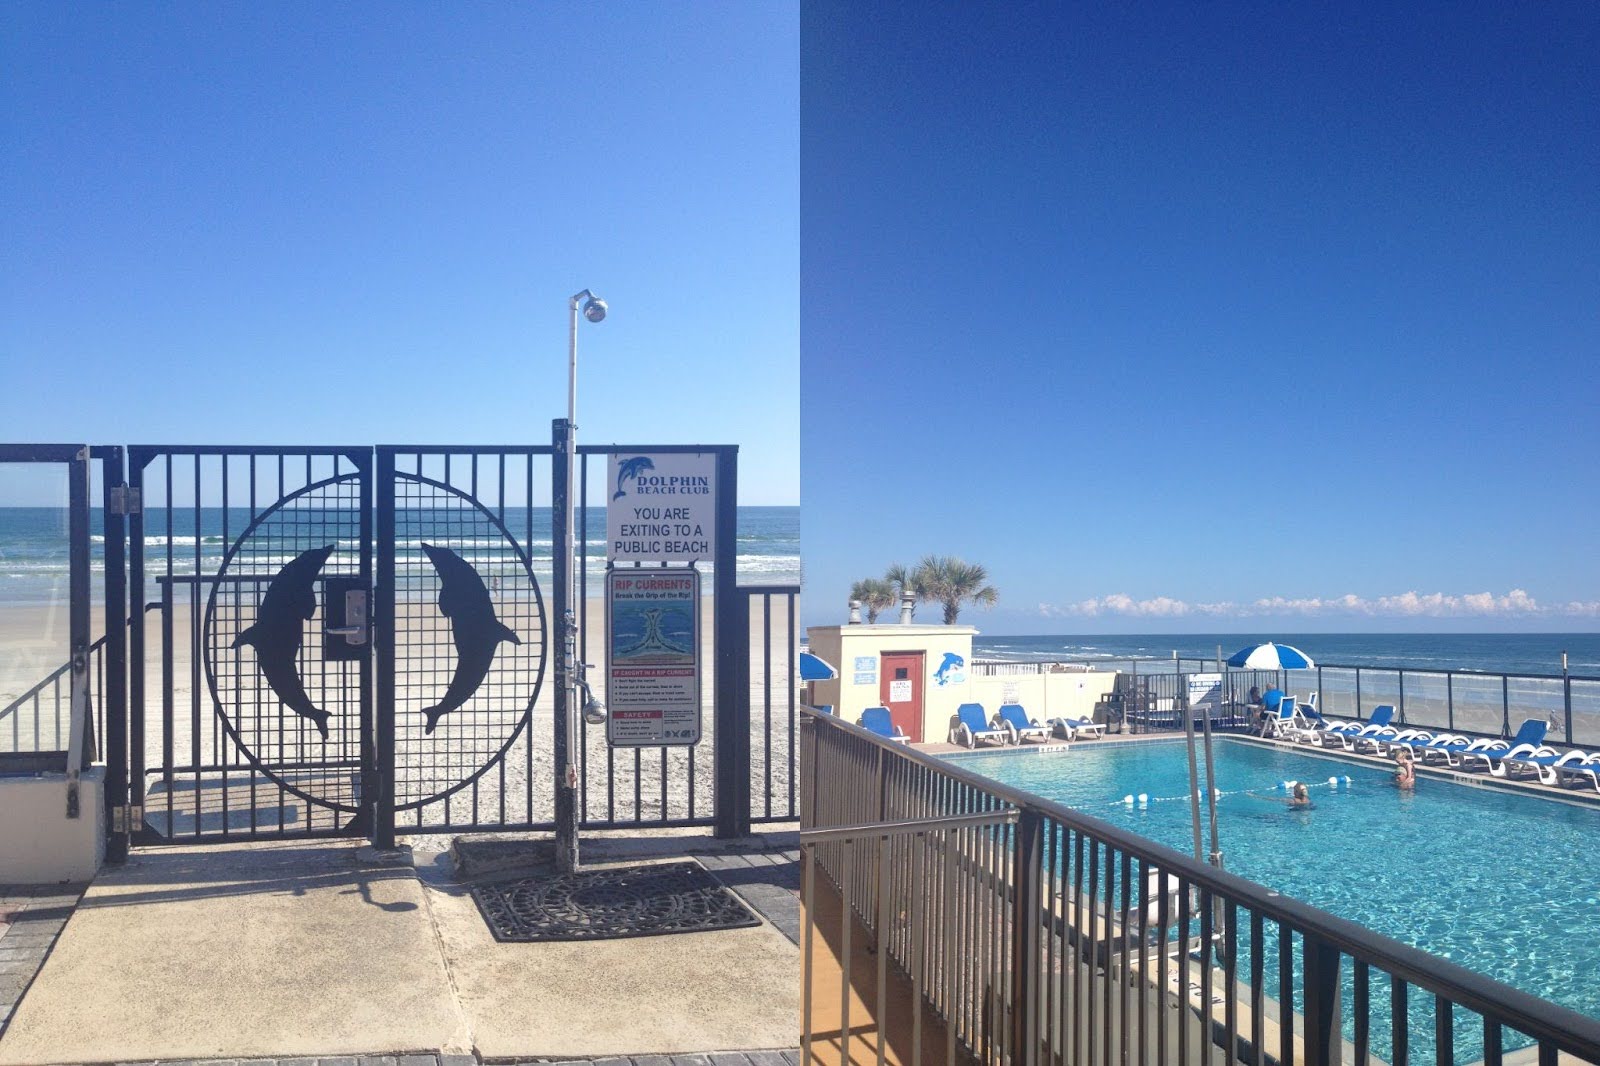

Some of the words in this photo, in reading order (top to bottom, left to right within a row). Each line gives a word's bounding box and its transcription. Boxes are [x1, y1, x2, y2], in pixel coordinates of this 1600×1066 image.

[637, 476, 708, 486] DOLPHIN
[637, 486, 676, 494] BEACH
[680, 486, 709, 494] CLUB
[634, 508, 660, 520] YOU
[664, 508, 690, 520] ARE
[621, 524, 670, 537] EXITING
[674, 524, 691, 537] TO
[694, 524, 703, 537] A
[615, 541, 661, 553] PUBLIC
[665, 541, 708, 553] BEACH
[615, 580, 633, 590] RIP
[635, 579, 692, 590] CURRENTS
